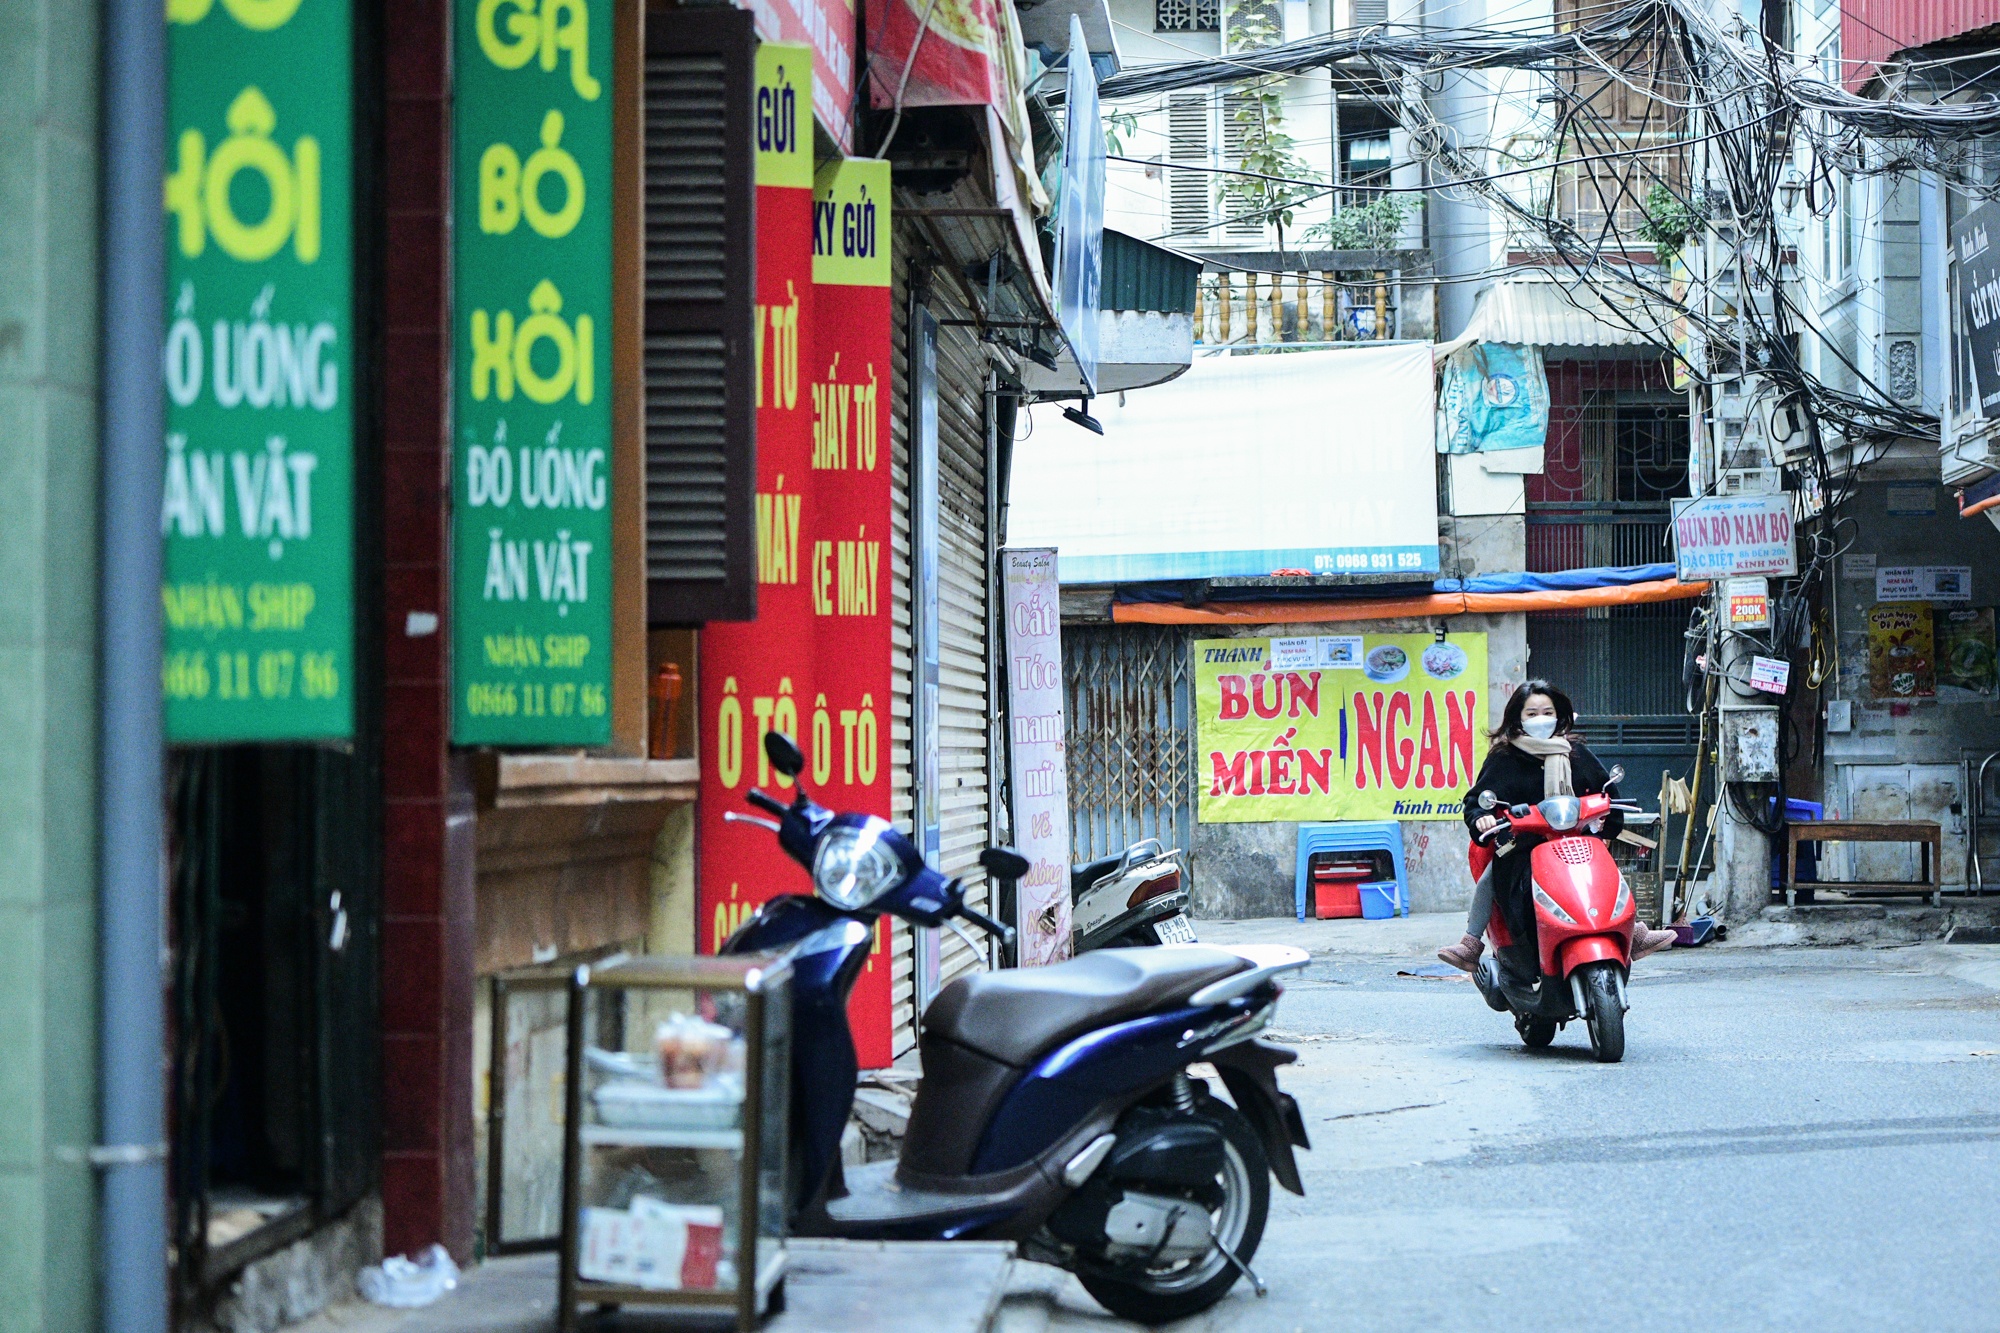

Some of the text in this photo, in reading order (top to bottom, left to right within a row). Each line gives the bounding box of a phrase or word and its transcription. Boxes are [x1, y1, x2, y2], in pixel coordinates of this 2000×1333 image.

[758, 65, 794, 153] GỬI
[479, 109, 586, 238] BÓ
[843, 184, 875, 259] GỬI
[212, 282, 339, 411] UỐNG
[770, 279, 799, 411] TỜ
[854, 362, 877, 472] TỜ
[519, 419, 607, 511] UỐNG
[755, 474, 801, 584] MÁY
[1677, 507, 1789, 548] BÚN BÒ NAM BỘ
[482, 528, 529, 603] ĂN
[838, 524, 880, 616] MÁY
[1012, 556, 1050, 570] Beauty Salon
[1336, 553, 1368, 568] 0968
[1371, 553, 1393, 567] 931
[1397, 552, 1421, 567] 525
[1683, 549, 1734, 571] ĐẶC BIỆT
[248, 581, 316, 632] SHIP
[1014, 594, 1055, 637] Cắt
[1735, 604, 1762, 615] 200K
[218, 651, 250, 699] 11
[257, 650, 296, 699] 07
[543, 633, 590, 668] SHIP
[1015, 654, 1057, 690] Tóc
[1204, 647, 1263, 663] THANH
[524, 682, 545, 717] 11
[551, 682, 576, 717] 07
[1217, 660, 1322, 720] BÚN
[718, 676, 797, 789] Ô TÔ
[812, 693, 877, 786] Ô TÔ
[1014, 714, 1061, 744] nam
[1353, 690, 1477, 790] NGAN
[1026, 760, 1054, 797] nữ
[1209, 726, 1332, 797] MIẾN
[1393, 798, 1466, 815] Kính mờ
